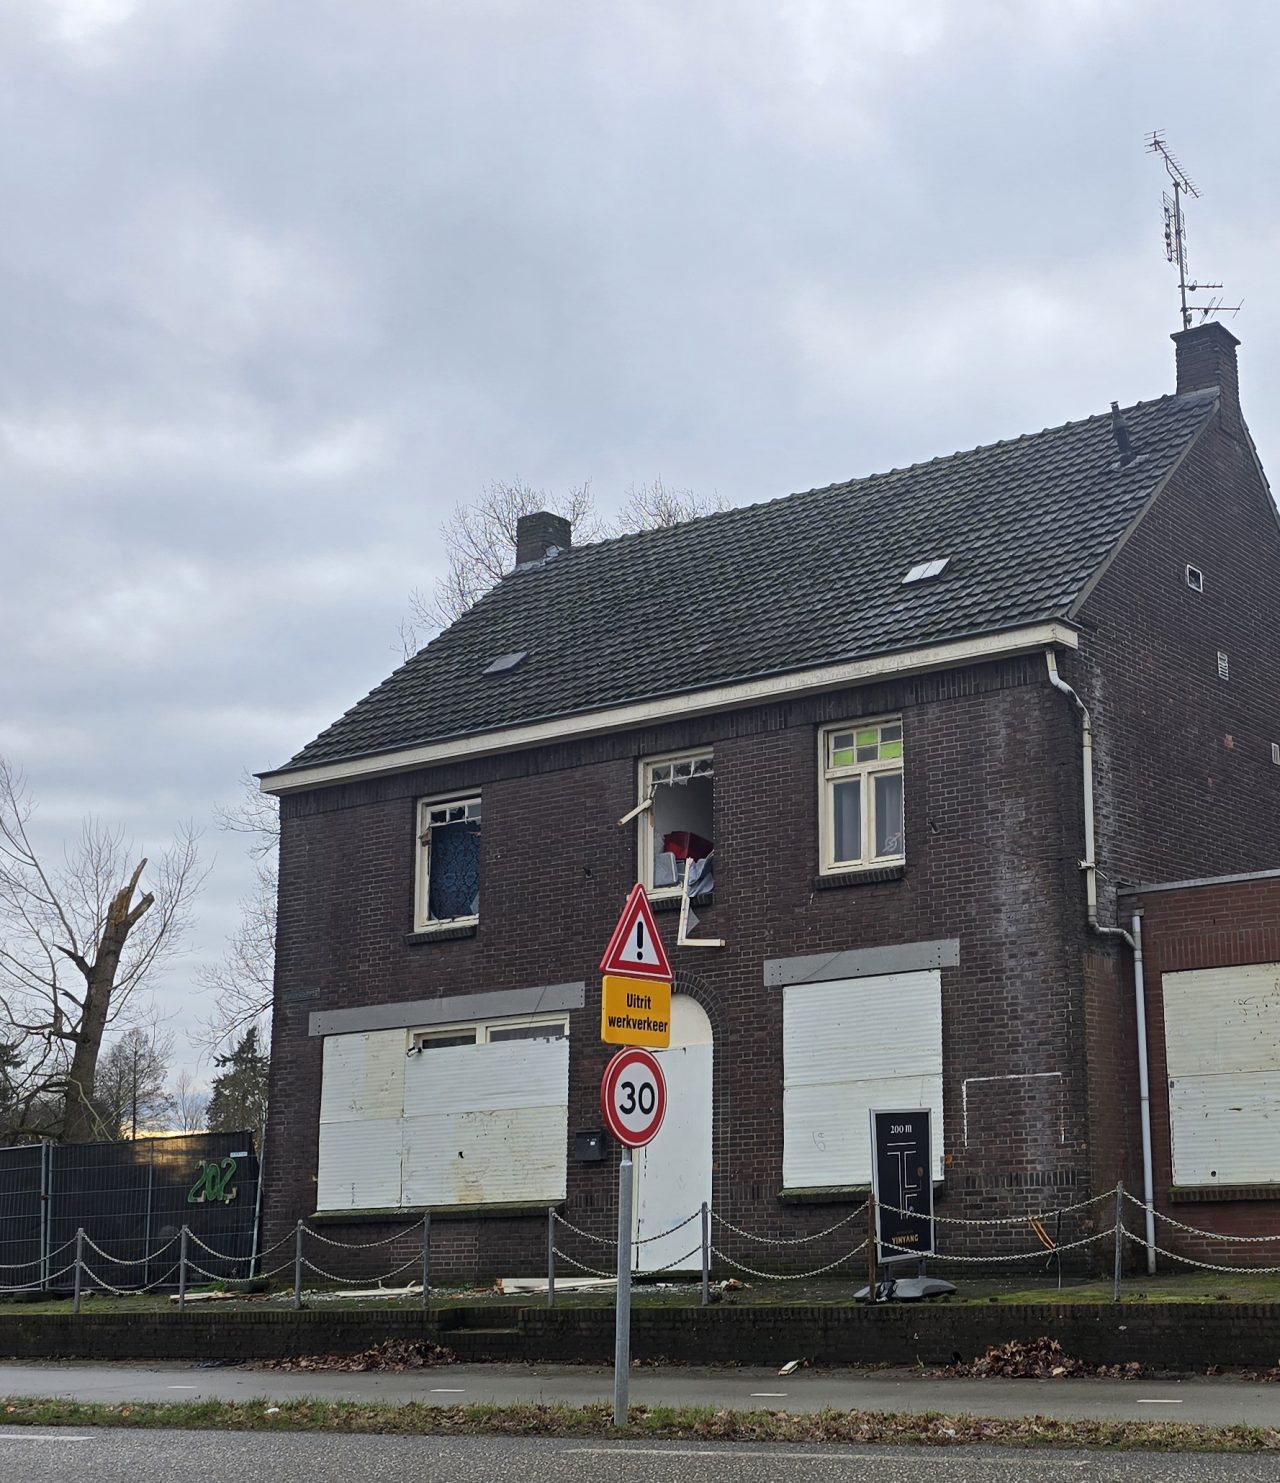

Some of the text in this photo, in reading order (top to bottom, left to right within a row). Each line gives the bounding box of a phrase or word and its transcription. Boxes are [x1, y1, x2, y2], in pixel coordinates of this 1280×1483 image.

[626, 992, 652, 1010] Uitrit
[608, 1014, 668, 1033] werkverkeer
[619, 1081, 656, 1115] 30
[890, 1124, 904, 1134] 200
